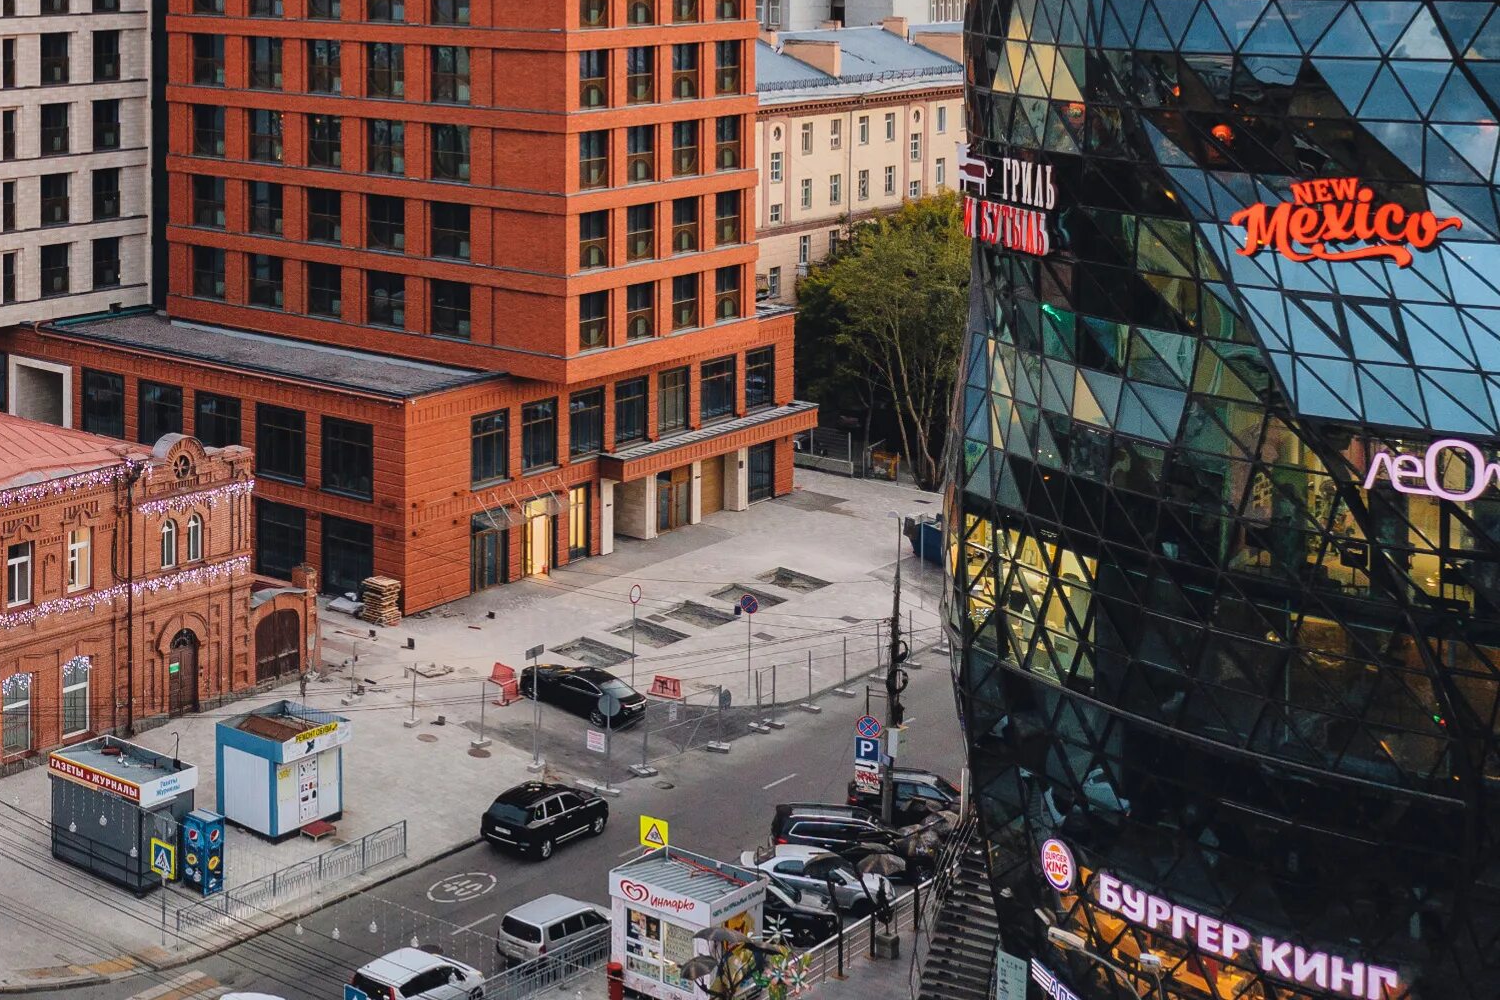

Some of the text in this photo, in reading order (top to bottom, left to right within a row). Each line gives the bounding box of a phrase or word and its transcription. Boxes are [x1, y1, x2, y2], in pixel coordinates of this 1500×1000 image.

[1003, 158, 1055, 210] ГРИЛЬ
[1290, 177, 1358, 205] NEW
[964, 196, 1049, 256] И БУТЫЛЬ
[1230, 187, 1463, 269] Mexico
[296, 724, 332, 742] РЕМОНТ ОБУВИ
[861, 740, 874, 757] P
[51, 758, 84, 779] ГАЗЕТЫ
[92, 773, 138, 797] ЖУРНАЛЫ
[1045, 851, 1068, 863] BURGER
[1046, 861, 1068, 876] KING
[1099, 873, 1398, 1000] БУРГЕР КИНГ
